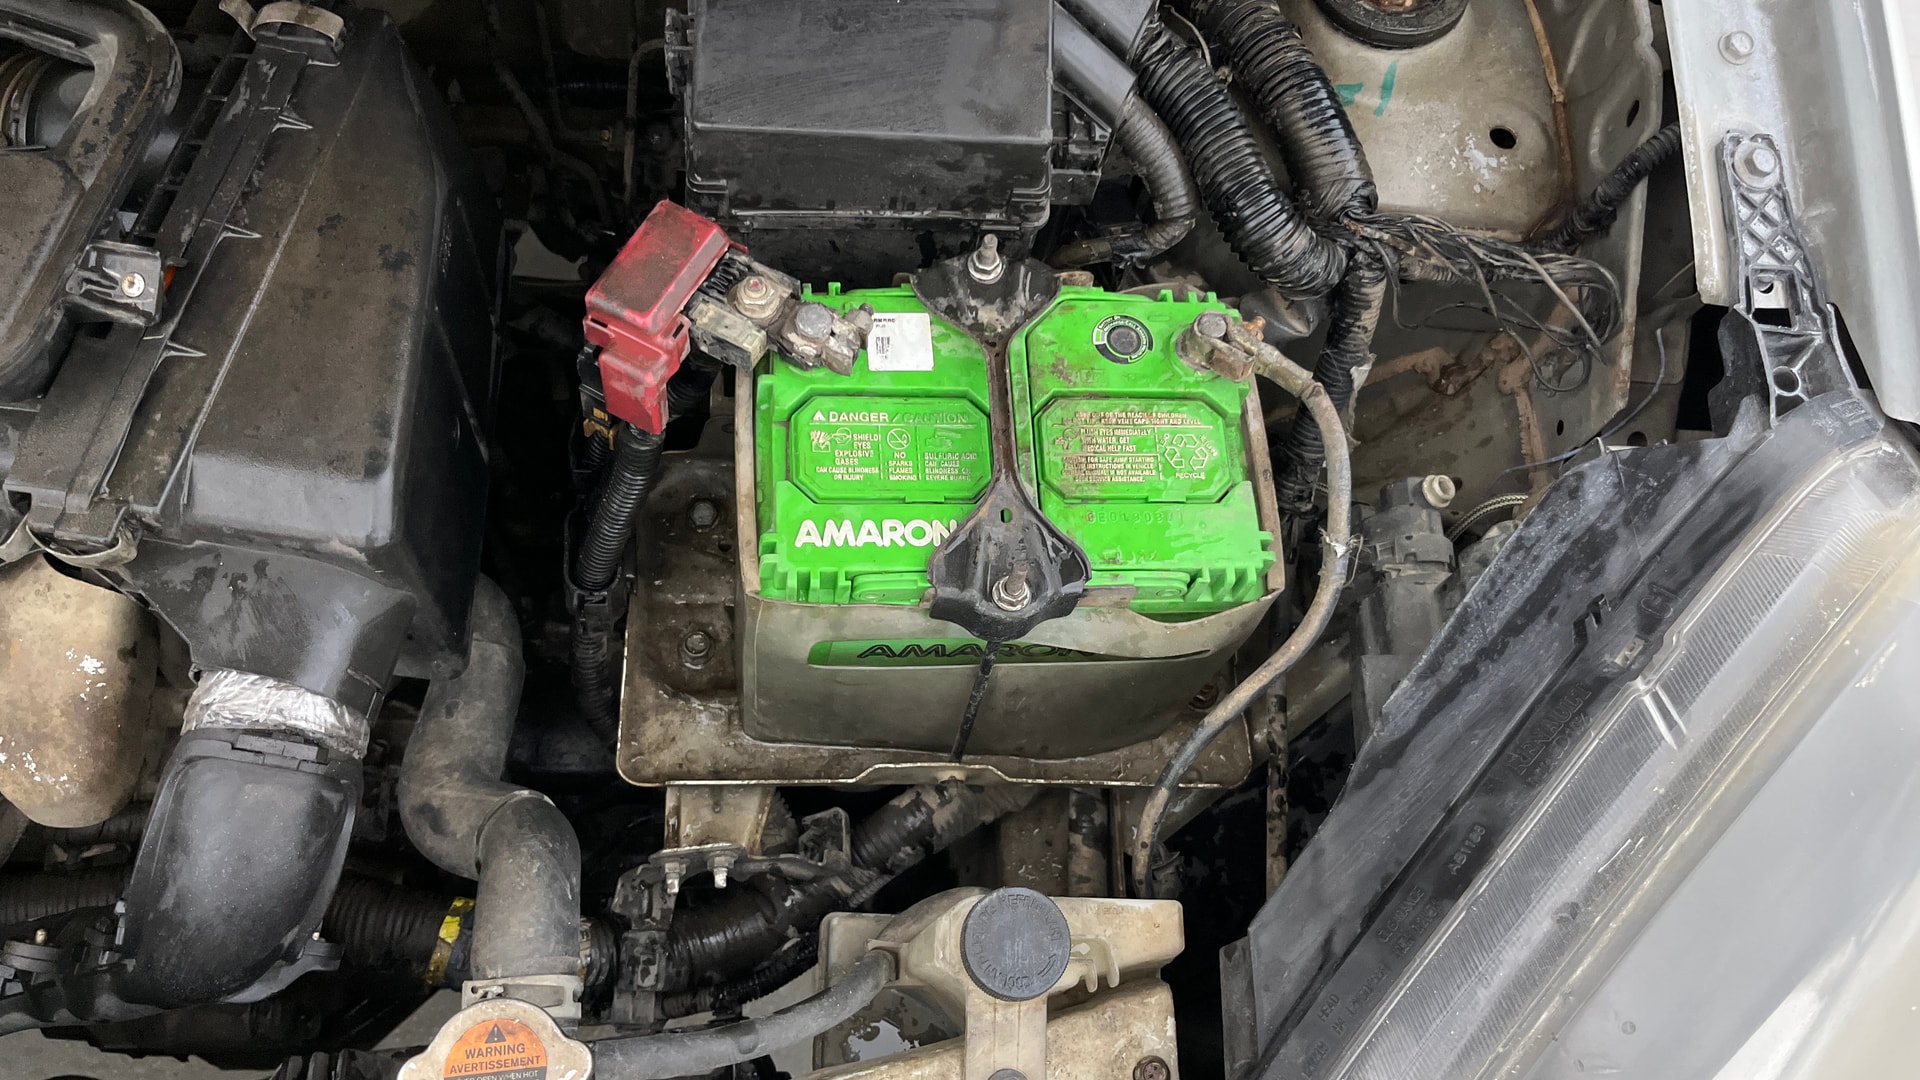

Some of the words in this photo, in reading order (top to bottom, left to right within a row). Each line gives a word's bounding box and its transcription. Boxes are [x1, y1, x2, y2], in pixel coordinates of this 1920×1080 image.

[829, 411, 889, 423] DANGER
[902, 411, 969, 424] CAUTION
[853, 433, 879, 441] SHIELD
[853, 442, 872, 450] EYES
[1122, 444, 1136, 452] FAST
[834, 450, 874, 458] EXPLOSIVE
[894, 451, 906, 459] NO
[835, 458, 859, 466] GASES
[1175, 472, 1206, 480] RECYCLE
[795, 518, 958, 548] AMARON
[1317, 993, 1340, 1022] HEAD
[465, 1043, 526, 1060] WARNING
[450, 1055, 540, 1074] AVERTISSEMENT
[499, 1072, 521, 1080] WHEN
[523, 1070, 538, 1078] HOT
